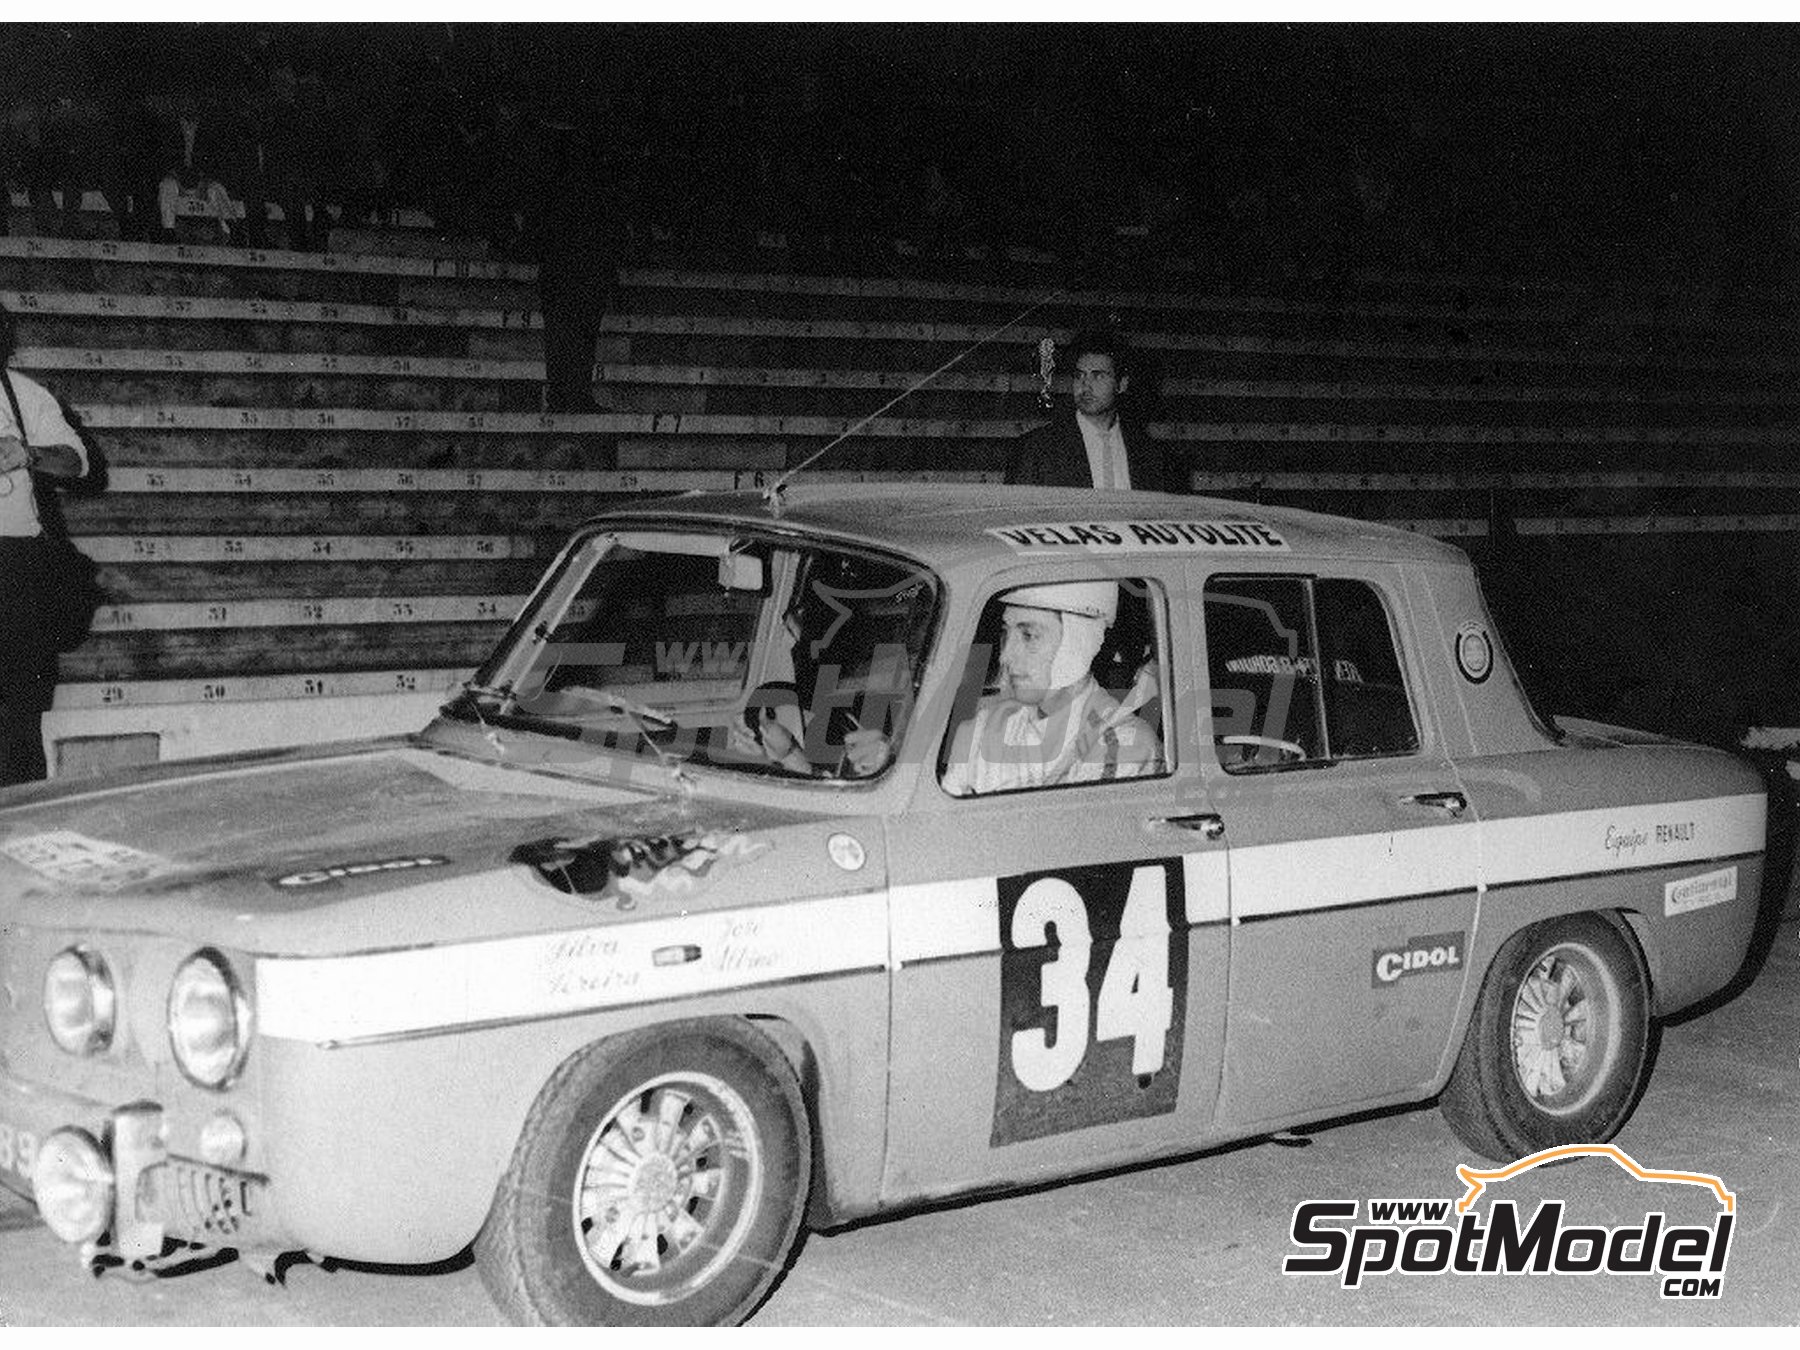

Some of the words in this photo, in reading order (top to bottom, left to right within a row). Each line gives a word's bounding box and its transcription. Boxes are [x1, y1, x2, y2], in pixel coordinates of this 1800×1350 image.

[1001, 524, 1123, 546] VELAS
[1129, 523, 1283, 546] AUTOLITE
[1656, 821, 1695, 844] RENAULT
[1376, 946, 1460, 981] CIDOL
[1011, 865, 1174, 1092] 34
